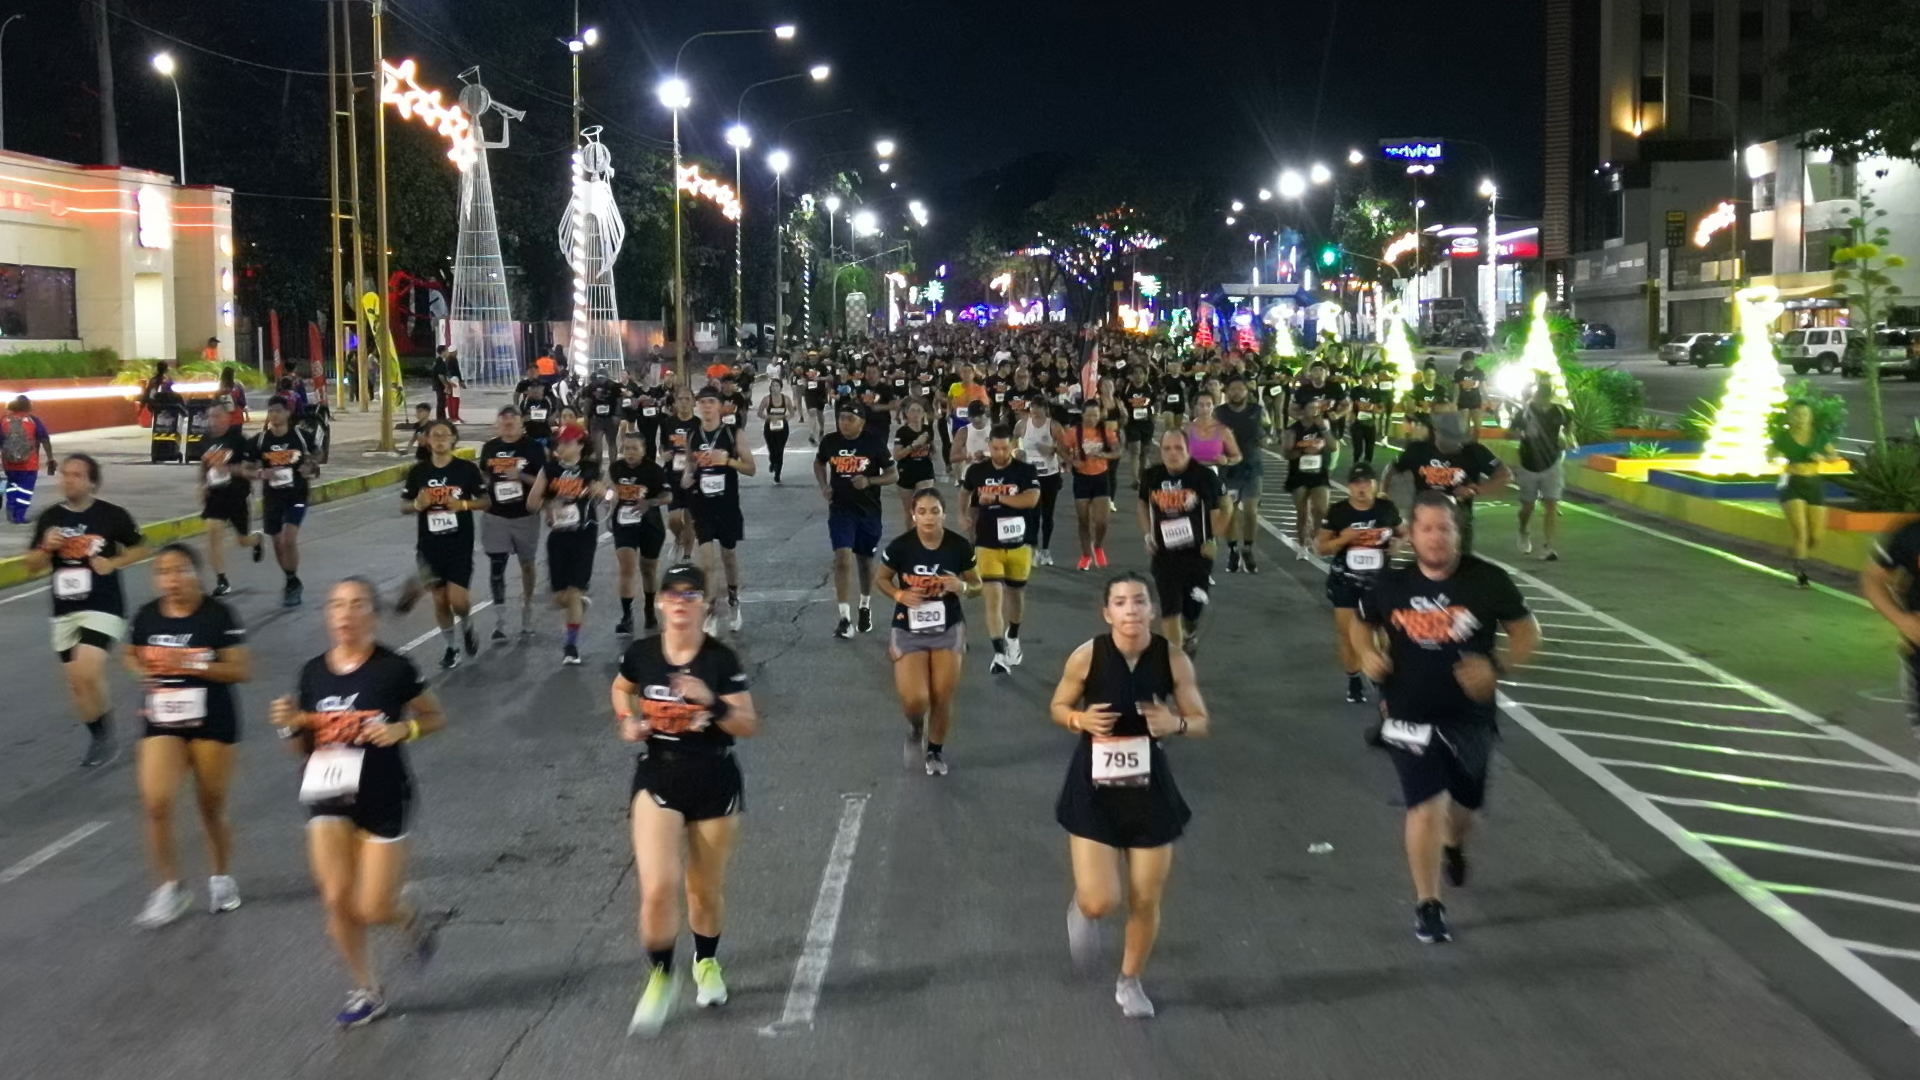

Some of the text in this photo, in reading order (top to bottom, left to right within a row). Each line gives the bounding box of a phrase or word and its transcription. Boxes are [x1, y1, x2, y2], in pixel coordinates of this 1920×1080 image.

[831, 456, 865, 467] NIGHT
[431, 518, 453, 530] 1714
[1103, 752, 1139, 768] 795
